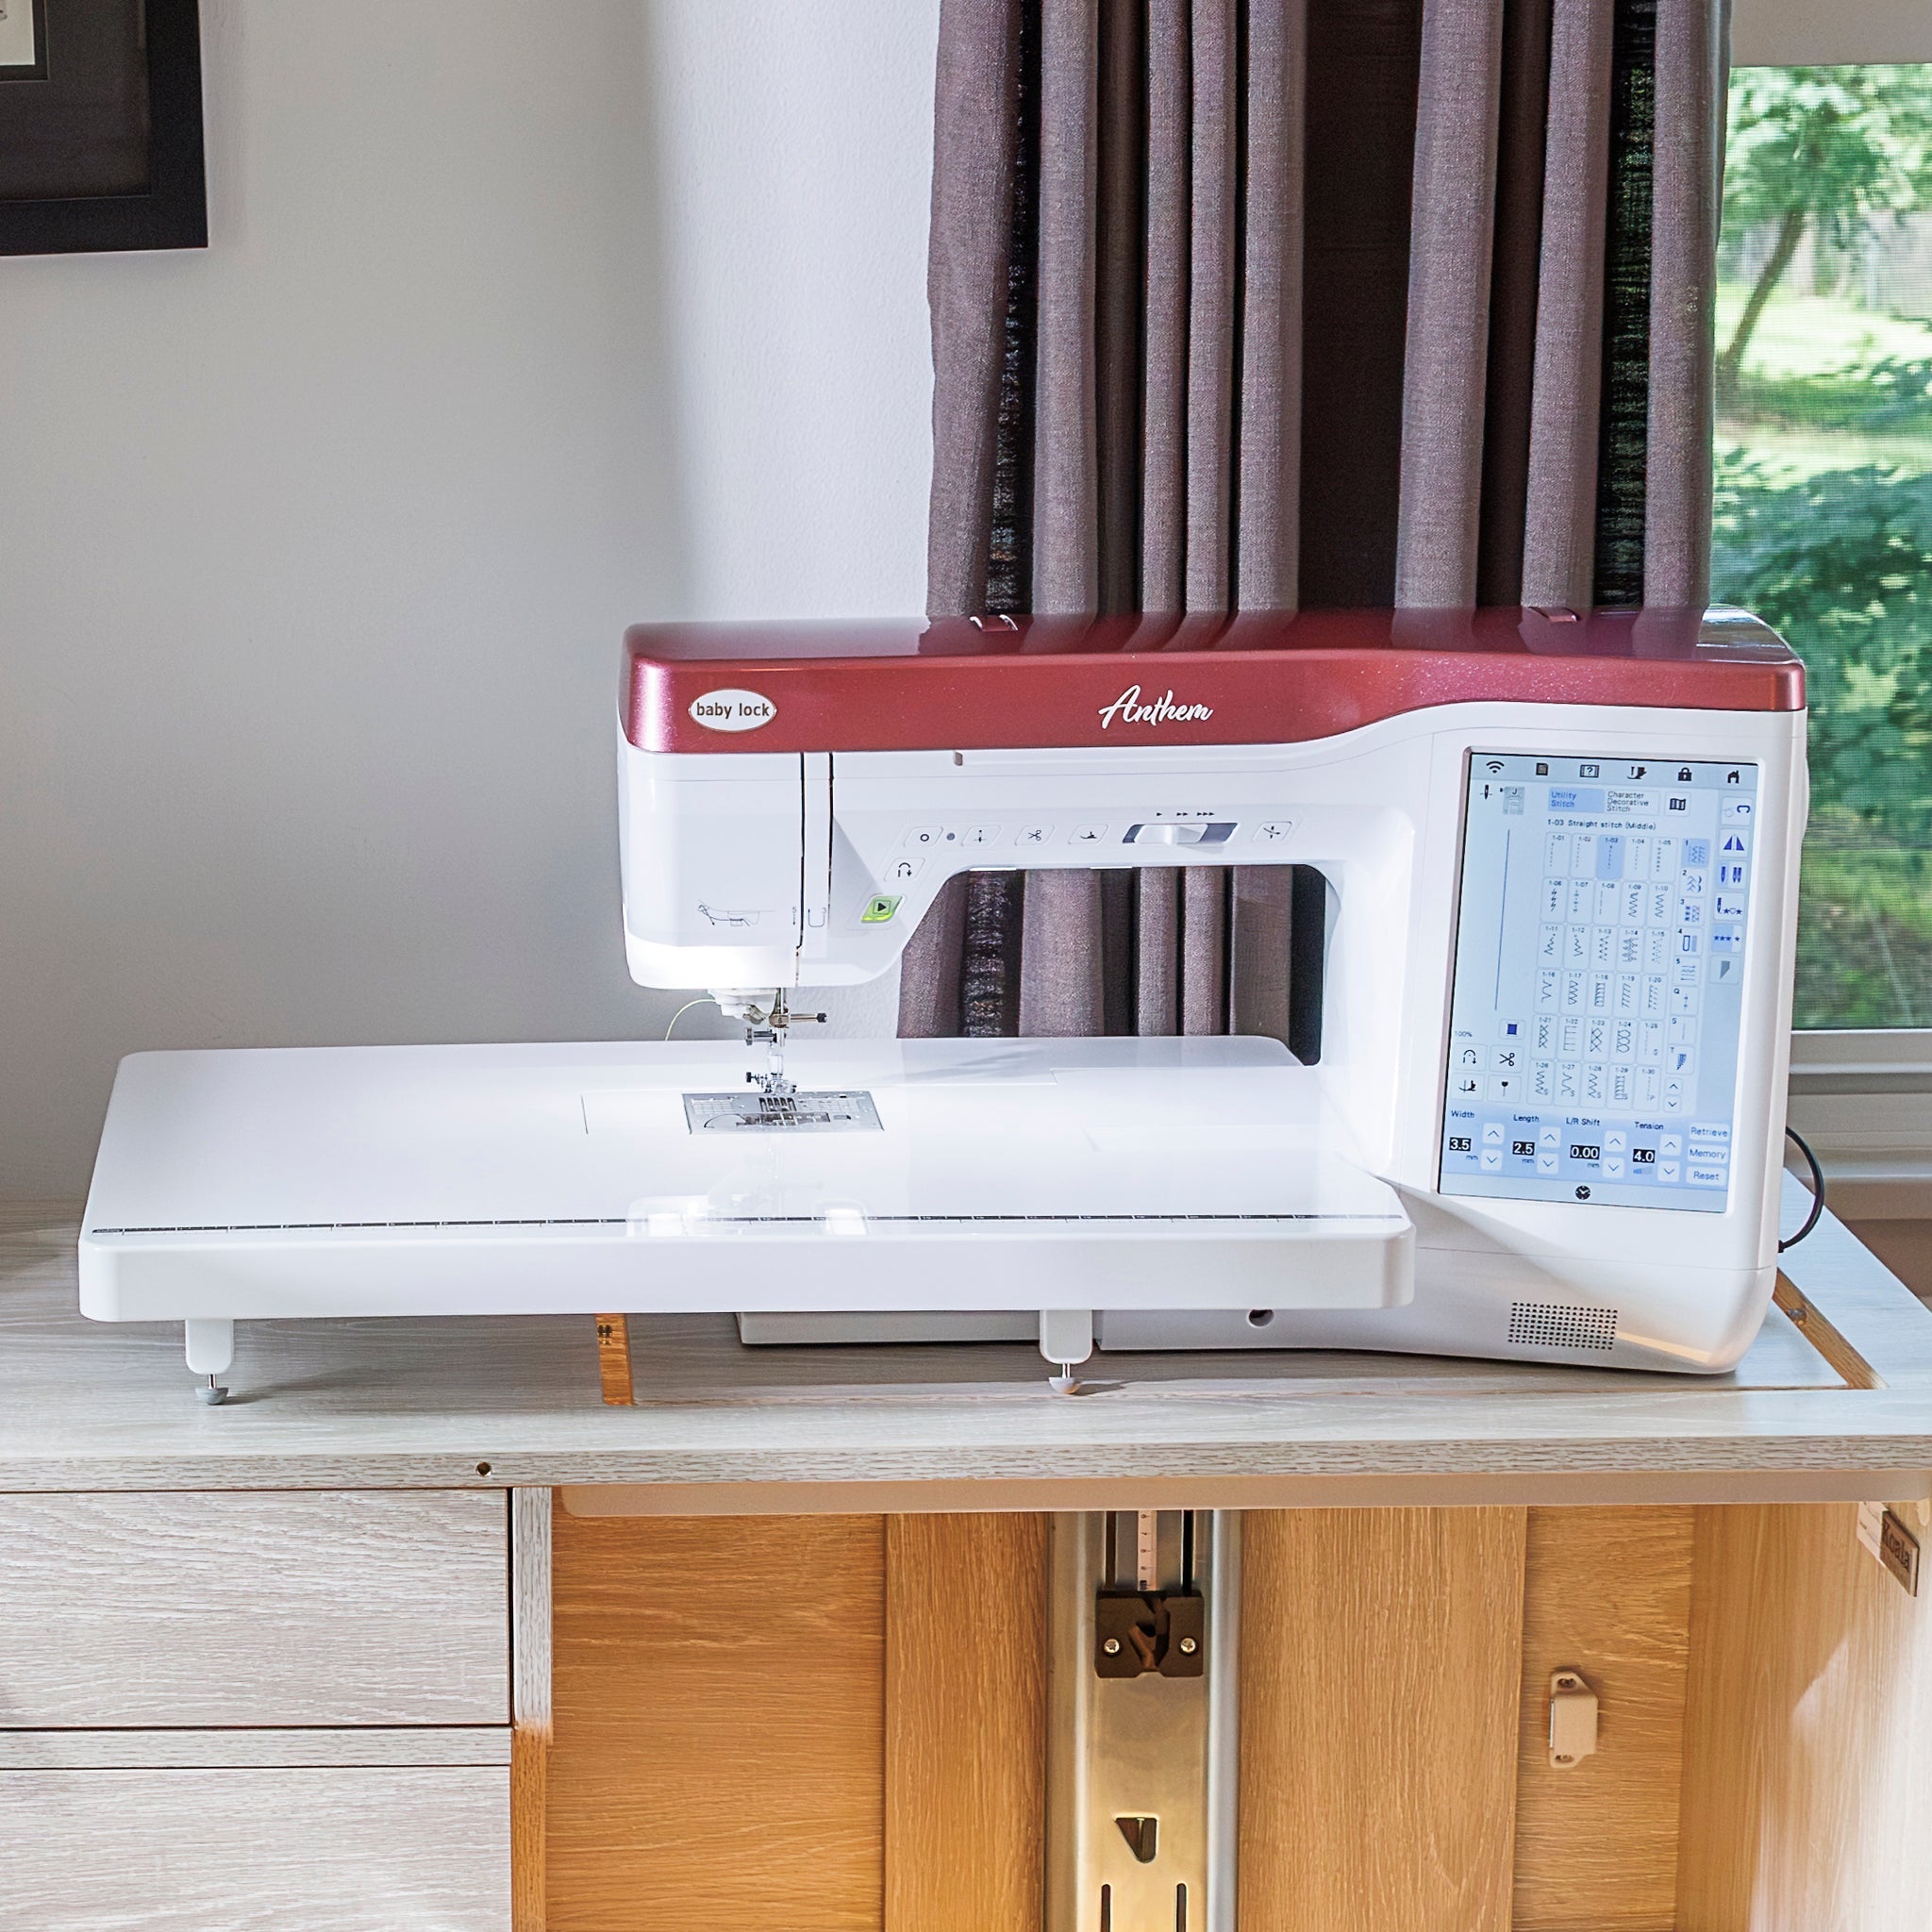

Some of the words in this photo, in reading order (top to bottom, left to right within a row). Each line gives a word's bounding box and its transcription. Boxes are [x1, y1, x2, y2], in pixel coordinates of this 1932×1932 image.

[696, 702, 732, 720] baby
[739, 703, 770, 716] lock
[1097, 684, 1214, 729] Anthem
[1551, 791, 1577, 800] Utility
[1607, 791, 1644, 799] Character
[1551, 799, 1575, 808] Stitch
[1607, 798, 1649, 807] Decorative
[1568, 819, 1598, 828] Straight
[1600, 821, 1624, 829] stitch
[1625, 822, 1657, 830] (Middle)
[1513, 1114, 1540, 1123] Length
[1566, 1117, 1579, 1125] L/R
[1581, 1118, 1601, 1126] Shift
[1635, 1122, 1664, 1130] Tension
[1690, 1126, 1728, 1138] Retrieve
[1450, 1138, 1470, 1150] 3.5
[1513, 1142, 1534, 1155] 2.5
[1571, 1146, 1599, 1158] 0.00
[1634, 1150, 1654, 1162] 4.0
[1690, 1148, 1726, 1159] Memory
[1692, 1170, 1720, 1180] Reset
